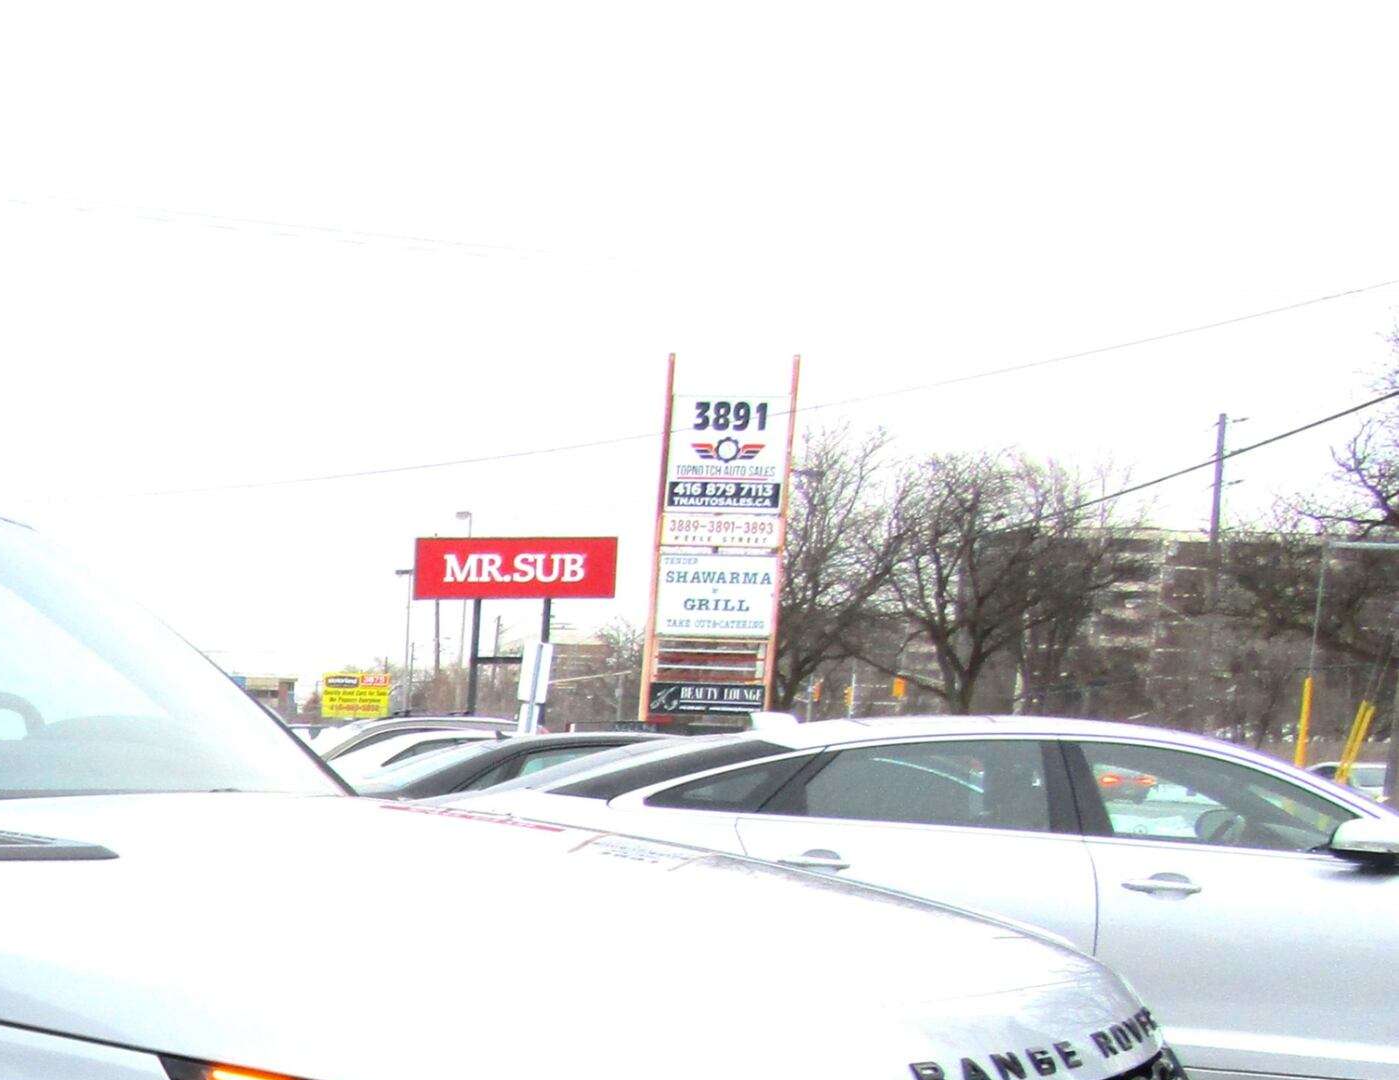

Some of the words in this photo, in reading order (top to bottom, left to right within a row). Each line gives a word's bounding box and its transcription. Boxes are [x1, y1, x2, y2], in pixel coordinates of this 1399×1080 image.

[693, 401, 768, 431] 3891
[723, 465, 747, 476] AUTO
[748, 466, 776, 477] SALES
[673, 482, 702, 496] 416
[705, 483, 736, 496] 879
[739, 484, 774, 497] 7113
[673, 496, 772, 507] TNAUTOSALES.CA
[669, 519, 774, 535] 3889-3891-3893
[443, 552, 586, 583] MR.SUB
[665, 570, 772, 585] SHAWARMA
[683, 598, 750, 612] GRILL
[666, 618, 691, 628] TAKE
[680, 686, 718, 699] BEAUTY
[723, 687, 762, 701] LOUNGE
